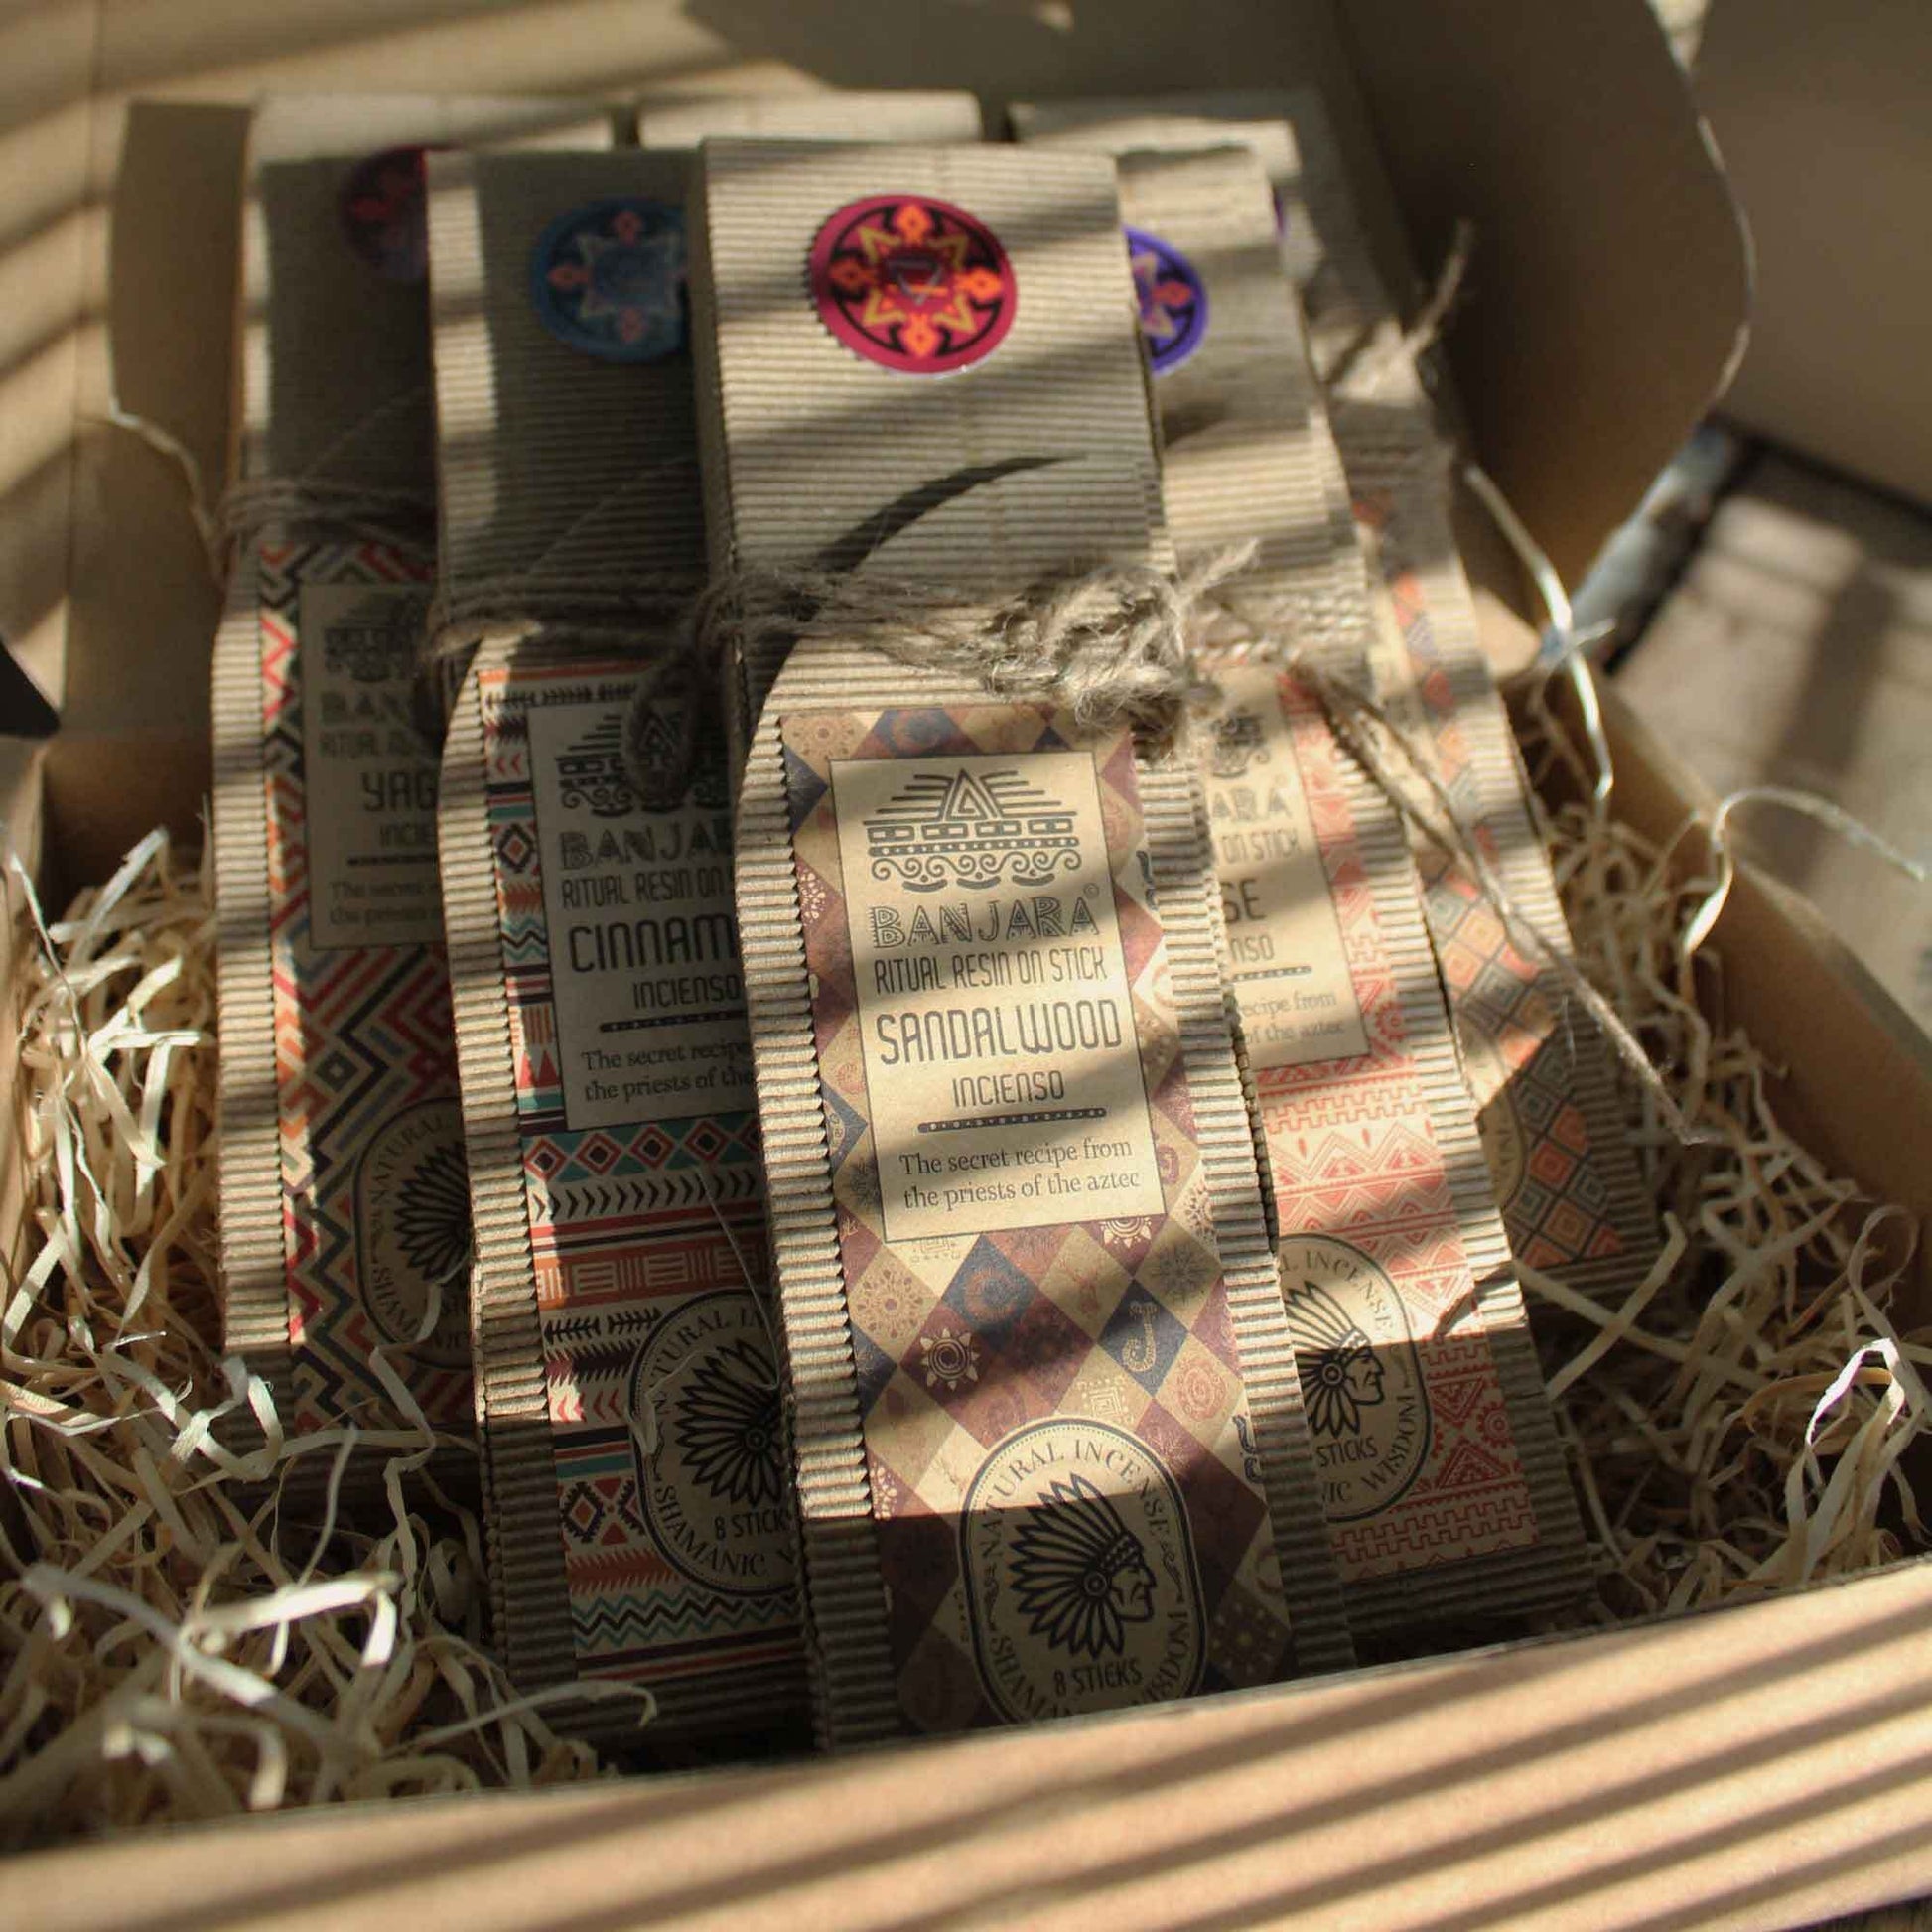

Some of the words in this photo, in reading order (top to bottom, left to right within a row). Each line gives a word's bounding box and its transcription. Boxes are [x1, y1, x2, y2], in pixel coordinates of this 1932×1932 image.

[562, 875, 630, 909] RITUAL
[635, 866, 692, 903] RESIN
[697, 865, 725, 897] ON
[569, 913, 738, 972] CINNAM
[868, 896, 1100, 949] BANJARA
[874, 953, 944, 994] RITUAL
[952, 950, 1013, 989] RESIN
[1017, 950, 1044, 985] ON
[1050, 946, 1108, 984] STICK
[633, 974, 741, 1009] INCIENSO
[1294, 990, 1337, 1010] from
[876, 999, 1123, 1065] SANDALWOOD
[582, 1048, 621, 1072] The
[627, 1044, 685, 1067] secret
[586, 1081, 619, 1103] the
[623, 1074, 691, 1104] priests
[695, 1065, 718, 1089] of
[952, 1070, 1065, 1107] INCIENSO
[898, 1151, 942, 1175] The
[947, 1147, 1011, 1172] secret
[1014, 1143, 1079, 1169] recipe
[1082, 1137, 1134, 1160] from
[903, 1186, 939, 1210] the
[942, 1178, 1017, 1212] priests
[1021, 1170, 1045, 1197] of
[1046, 1172, 1082, 1195] the
[1087, 1169, 1141, 1191] aztec
[1316, 1436, 1378, 1468] STICKS
[1360, 1395, 1415, 1491] WISDOM
[980, 1441, 1064, 1557] NATURAL
[1074, 1439, 1170, 1536] INCENSE
[655, 1485, 767, 1577] SHAMANIC
[715, 1515, 727, 1540] 8
[1072, 1657, 1143, 1694] STICKS
